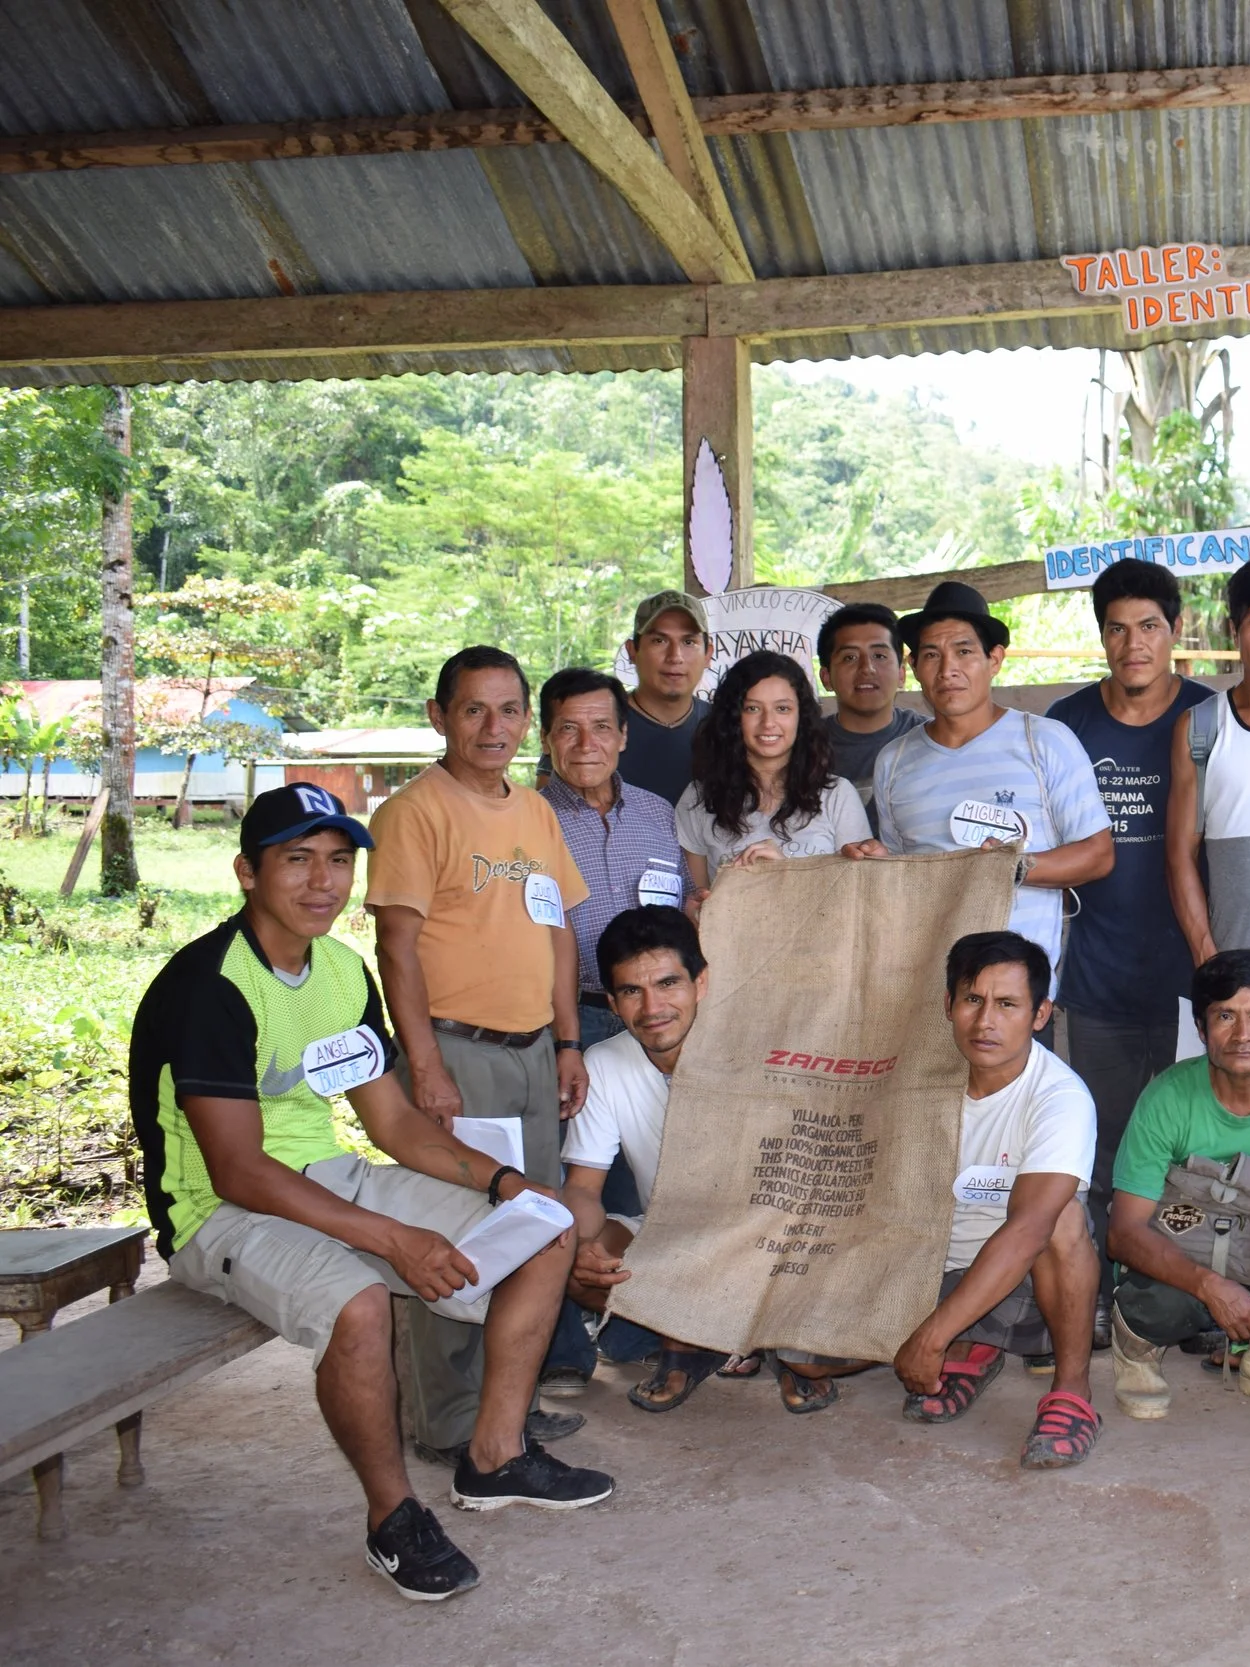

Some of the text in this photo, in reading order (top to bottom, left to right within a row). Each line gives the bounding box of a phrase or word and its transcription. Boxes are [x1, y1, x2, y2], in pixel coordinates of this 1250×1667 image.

[1065, 245, 1221, 291] TALLER:
[717, 591, 781, 614] VINCULO
[784, 592, 838, 622] ENTR
[1125, 775, 1161, 786] MARZO
[962, 803, 1009, 825] MIGUEL
[1105, 804, 1154, 815] EL AGUA
[317, 1036, 354, 1065] ANGEL
[764, 1049, 898, 1075] ZANESCO
[792, 1109, 819, 1124] VILLA
[821, 1114, 840, 1127] RICA
[791, 1124, 862, 1142] ORGANIC COFFEE
[759, 1137, 782, 1150] AND
[785, 1138, 813, 1154] 100%
[814, 1144, 855, 1157] ORGANIC
[760, 1152, 782, 1164] THIS
[785, 1152, 834, 1172] PRODUCTS
[759, 1180, 809, 1201] PRODUCTS
[966, 1177, 1009, 1189] ANGEL
[963, 1190, 1001, 1202] SOTO
[792, 1240, 809, 1253] OF
